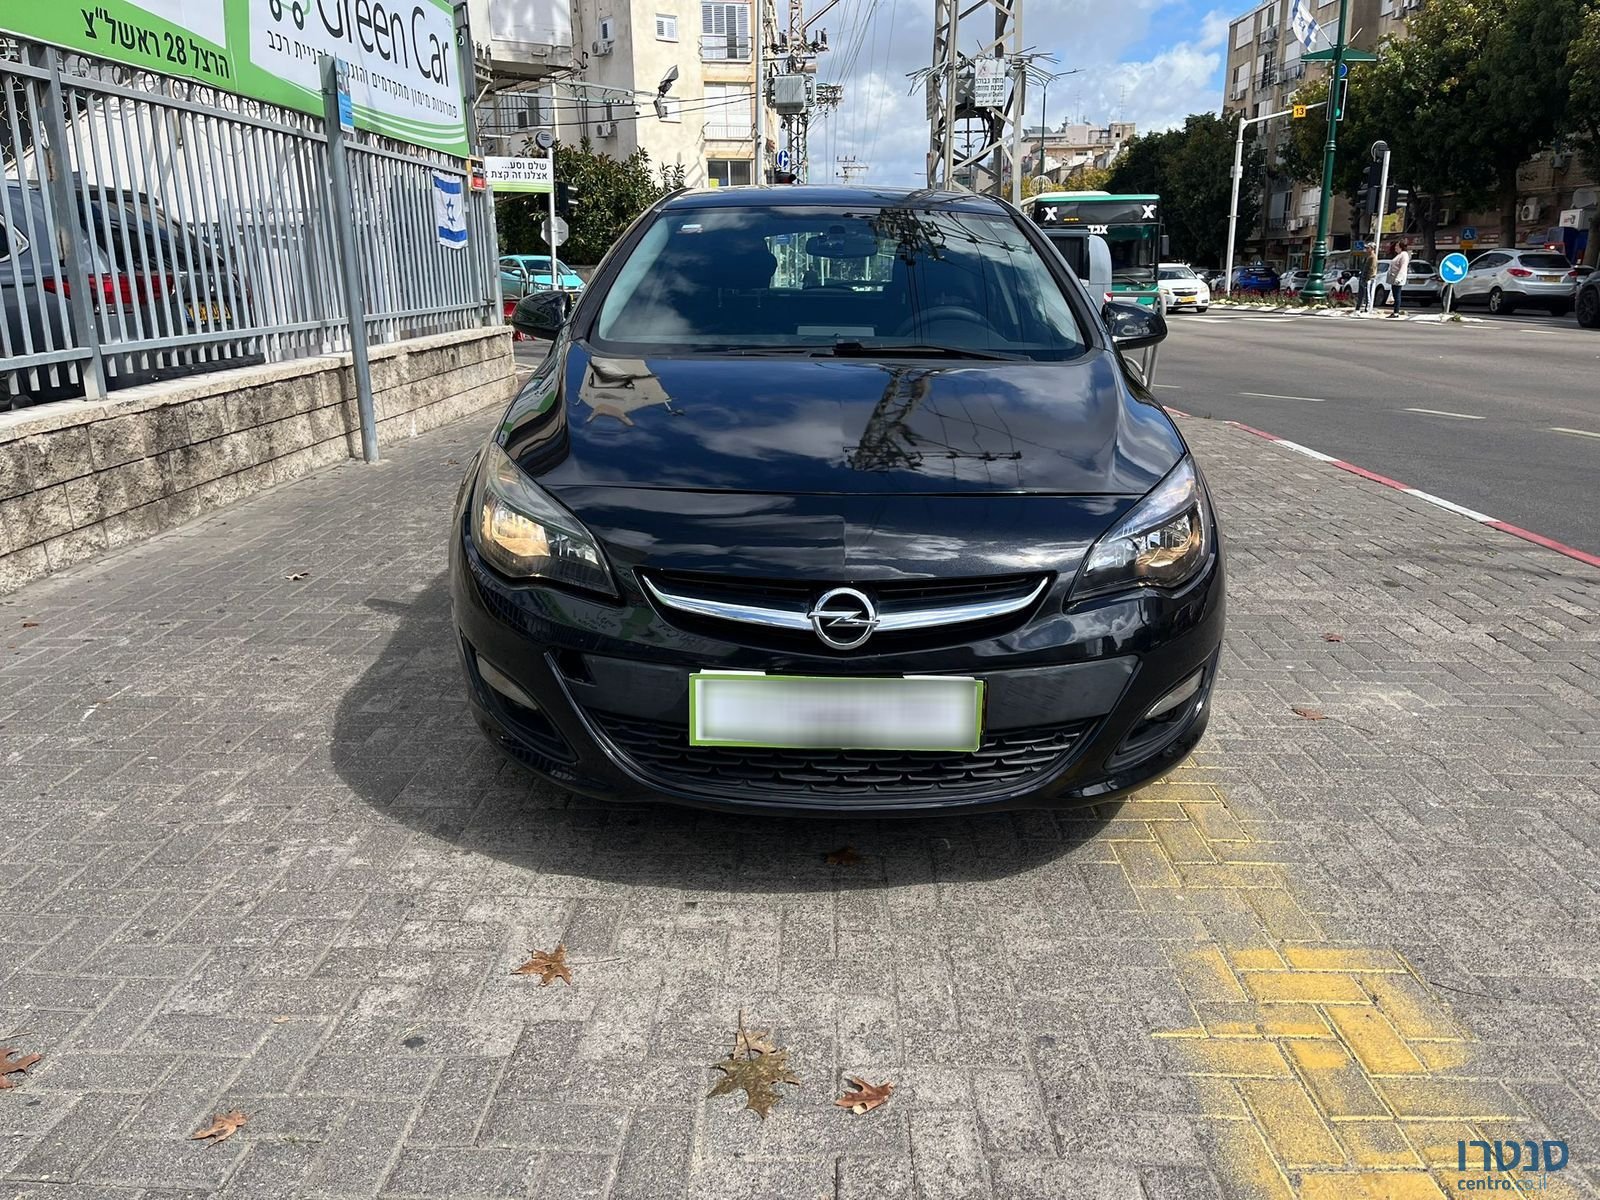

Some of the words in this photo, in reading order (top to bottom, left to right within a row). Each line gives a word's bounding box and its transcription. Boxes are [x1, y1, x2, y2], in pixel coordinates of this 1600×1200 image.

[164, 31, 187, 65] 28
[267, 30, 290, 55] רכב
[411, 6, 449, 87] Car
[189, 38, 229, 79] הרצל
[371, 72, 409, 100] מתקדמים
[411, 88, 431, 108] מימון
[1296, 107, 1304, 116] 13
[491, 170, 509, 180] קצת
[512, 171, 523, 179] זה
[524, 170, 548, 180] אצלנו
[528, 161, 547, 170] שלם
